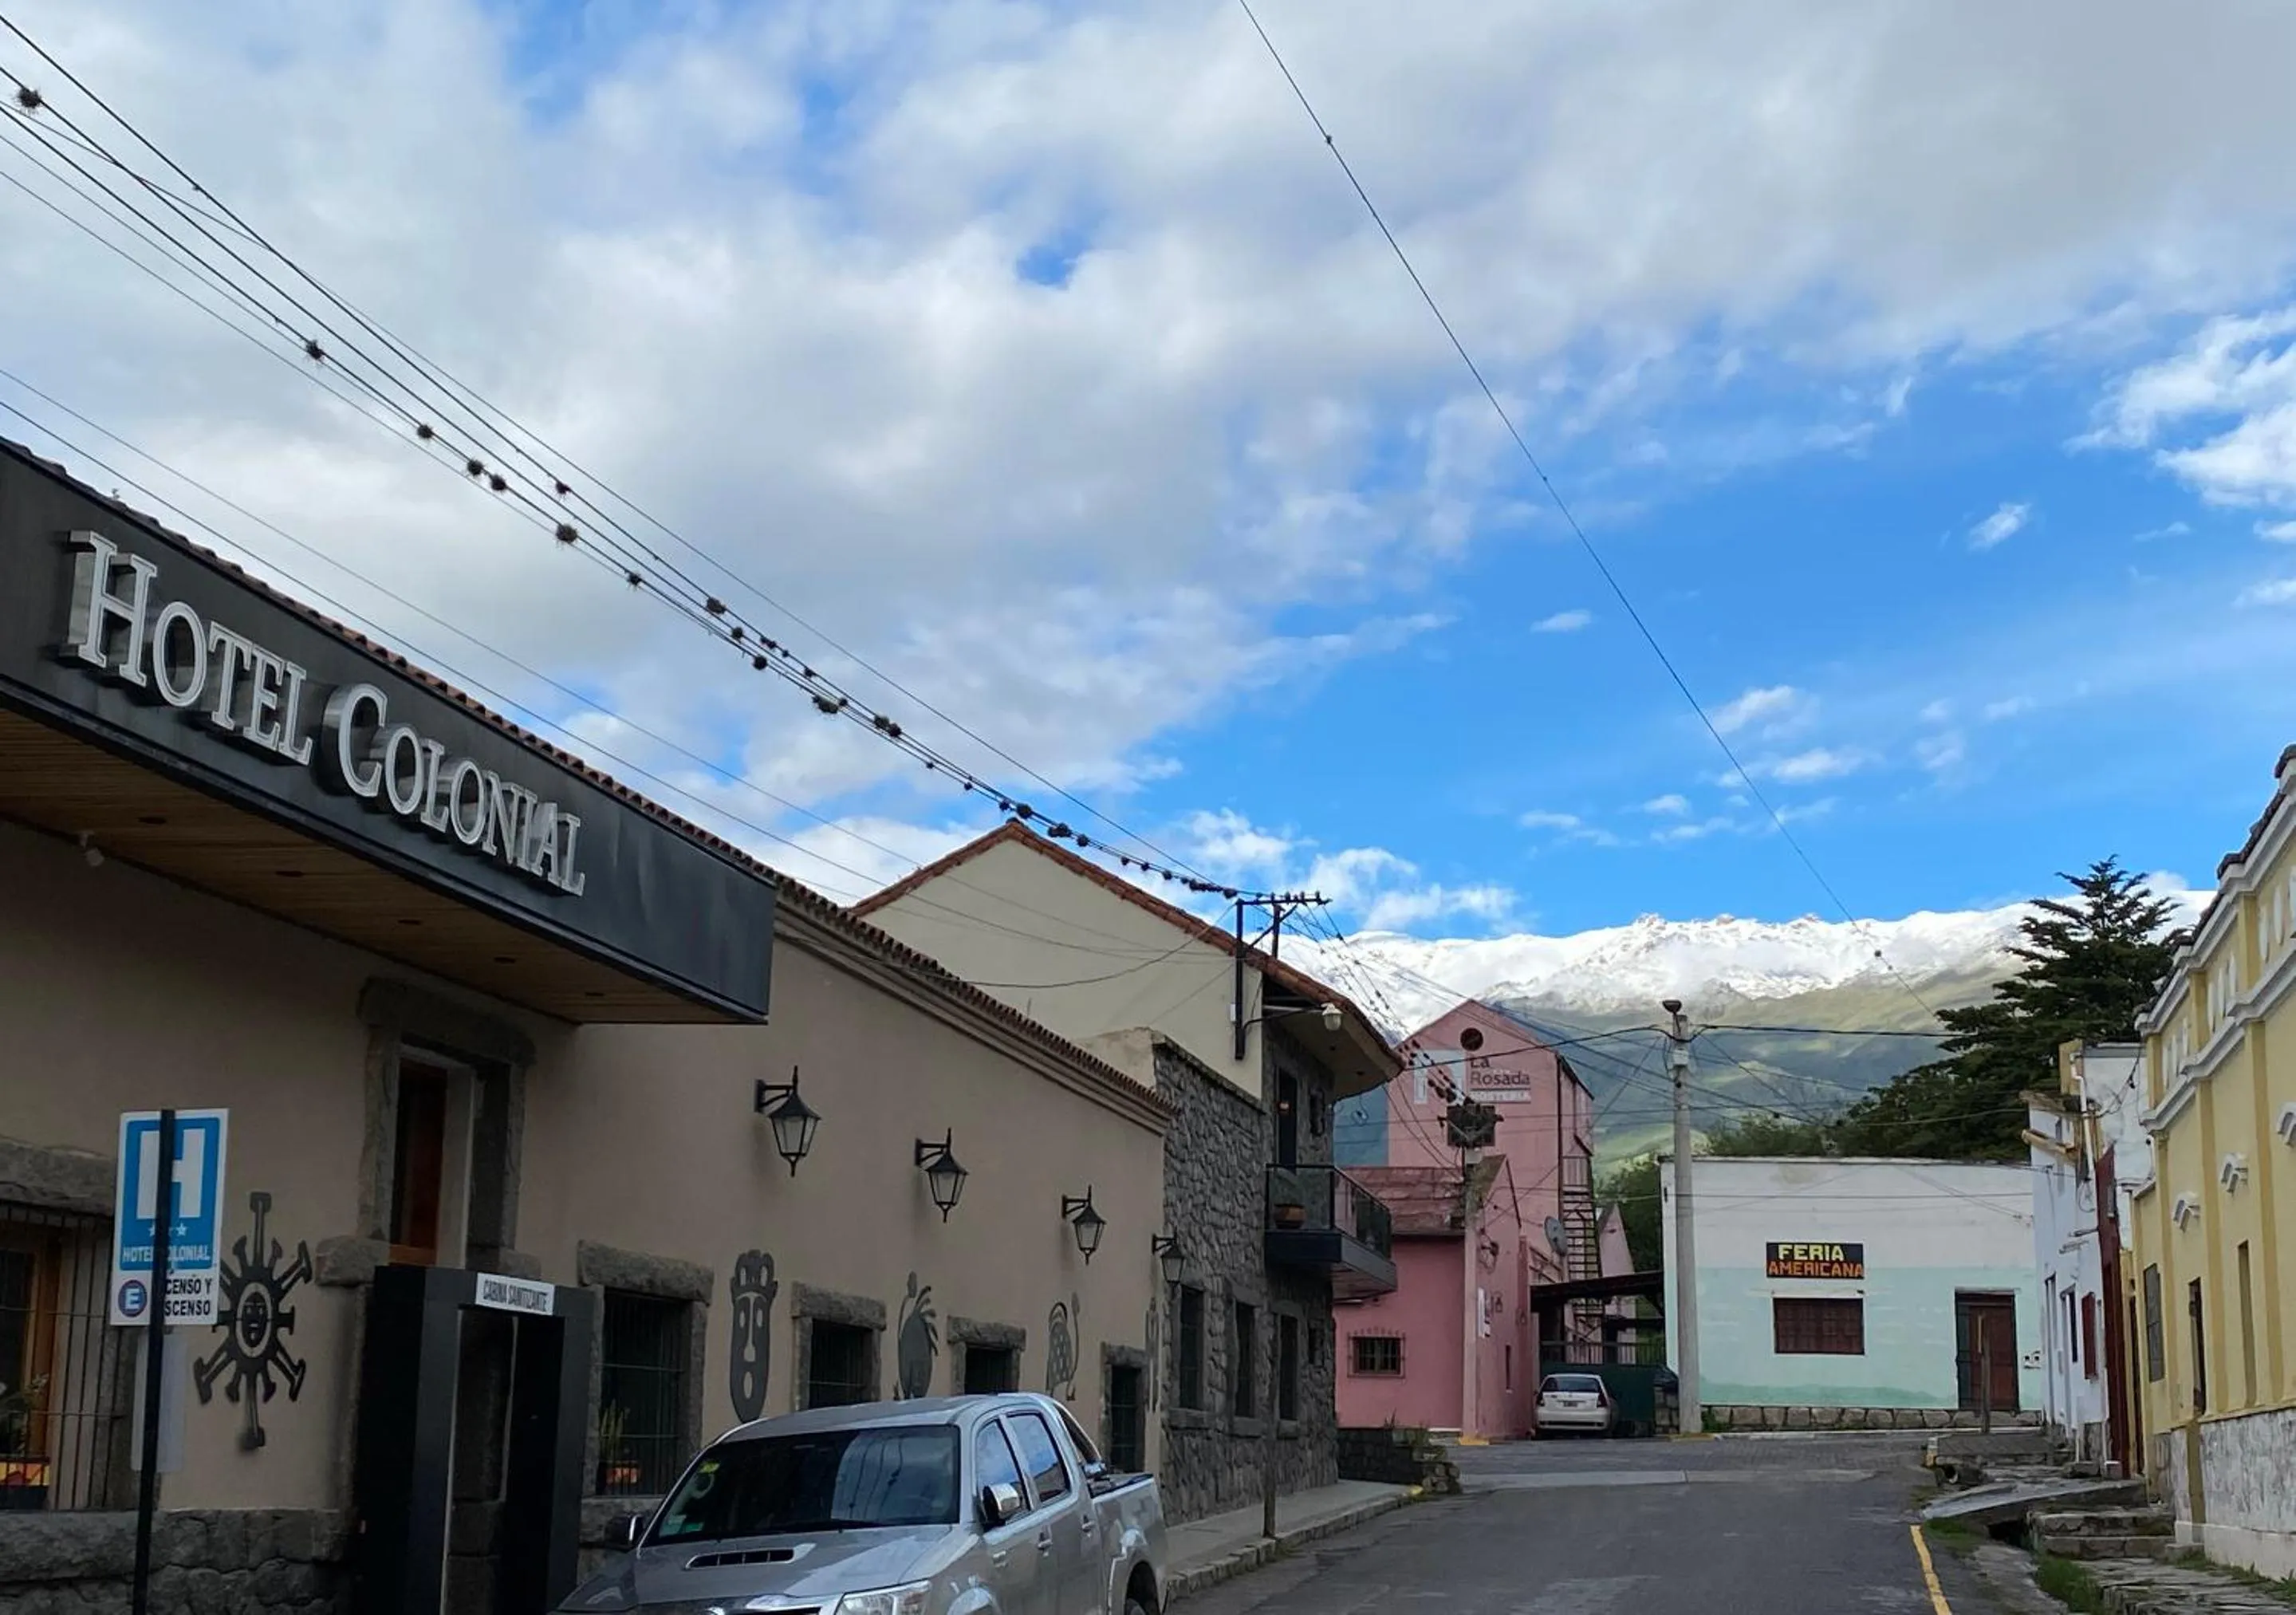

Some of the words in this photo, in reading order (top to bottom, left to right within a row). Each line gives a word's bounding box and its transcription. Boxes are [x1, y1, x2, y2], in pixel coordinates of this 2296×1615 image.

[69, 530, 314, 766] HOTEL
[322, 683, 585, 897] COLONIAL
[1471, 1071, 1530, 1085] Rosada
[136, 1128, 206, 1219] H
[1778, 1244, 1844, 1261] FERIA
[1769, 1262, 1863, 1277] AMERICANA
[164, 1278, 202, 1294] CENSO
[204, 1277, 213, 1294] Y
[124, 1287, 140, 1310] E
[164, 1299, 211, 1316] SCENSO
